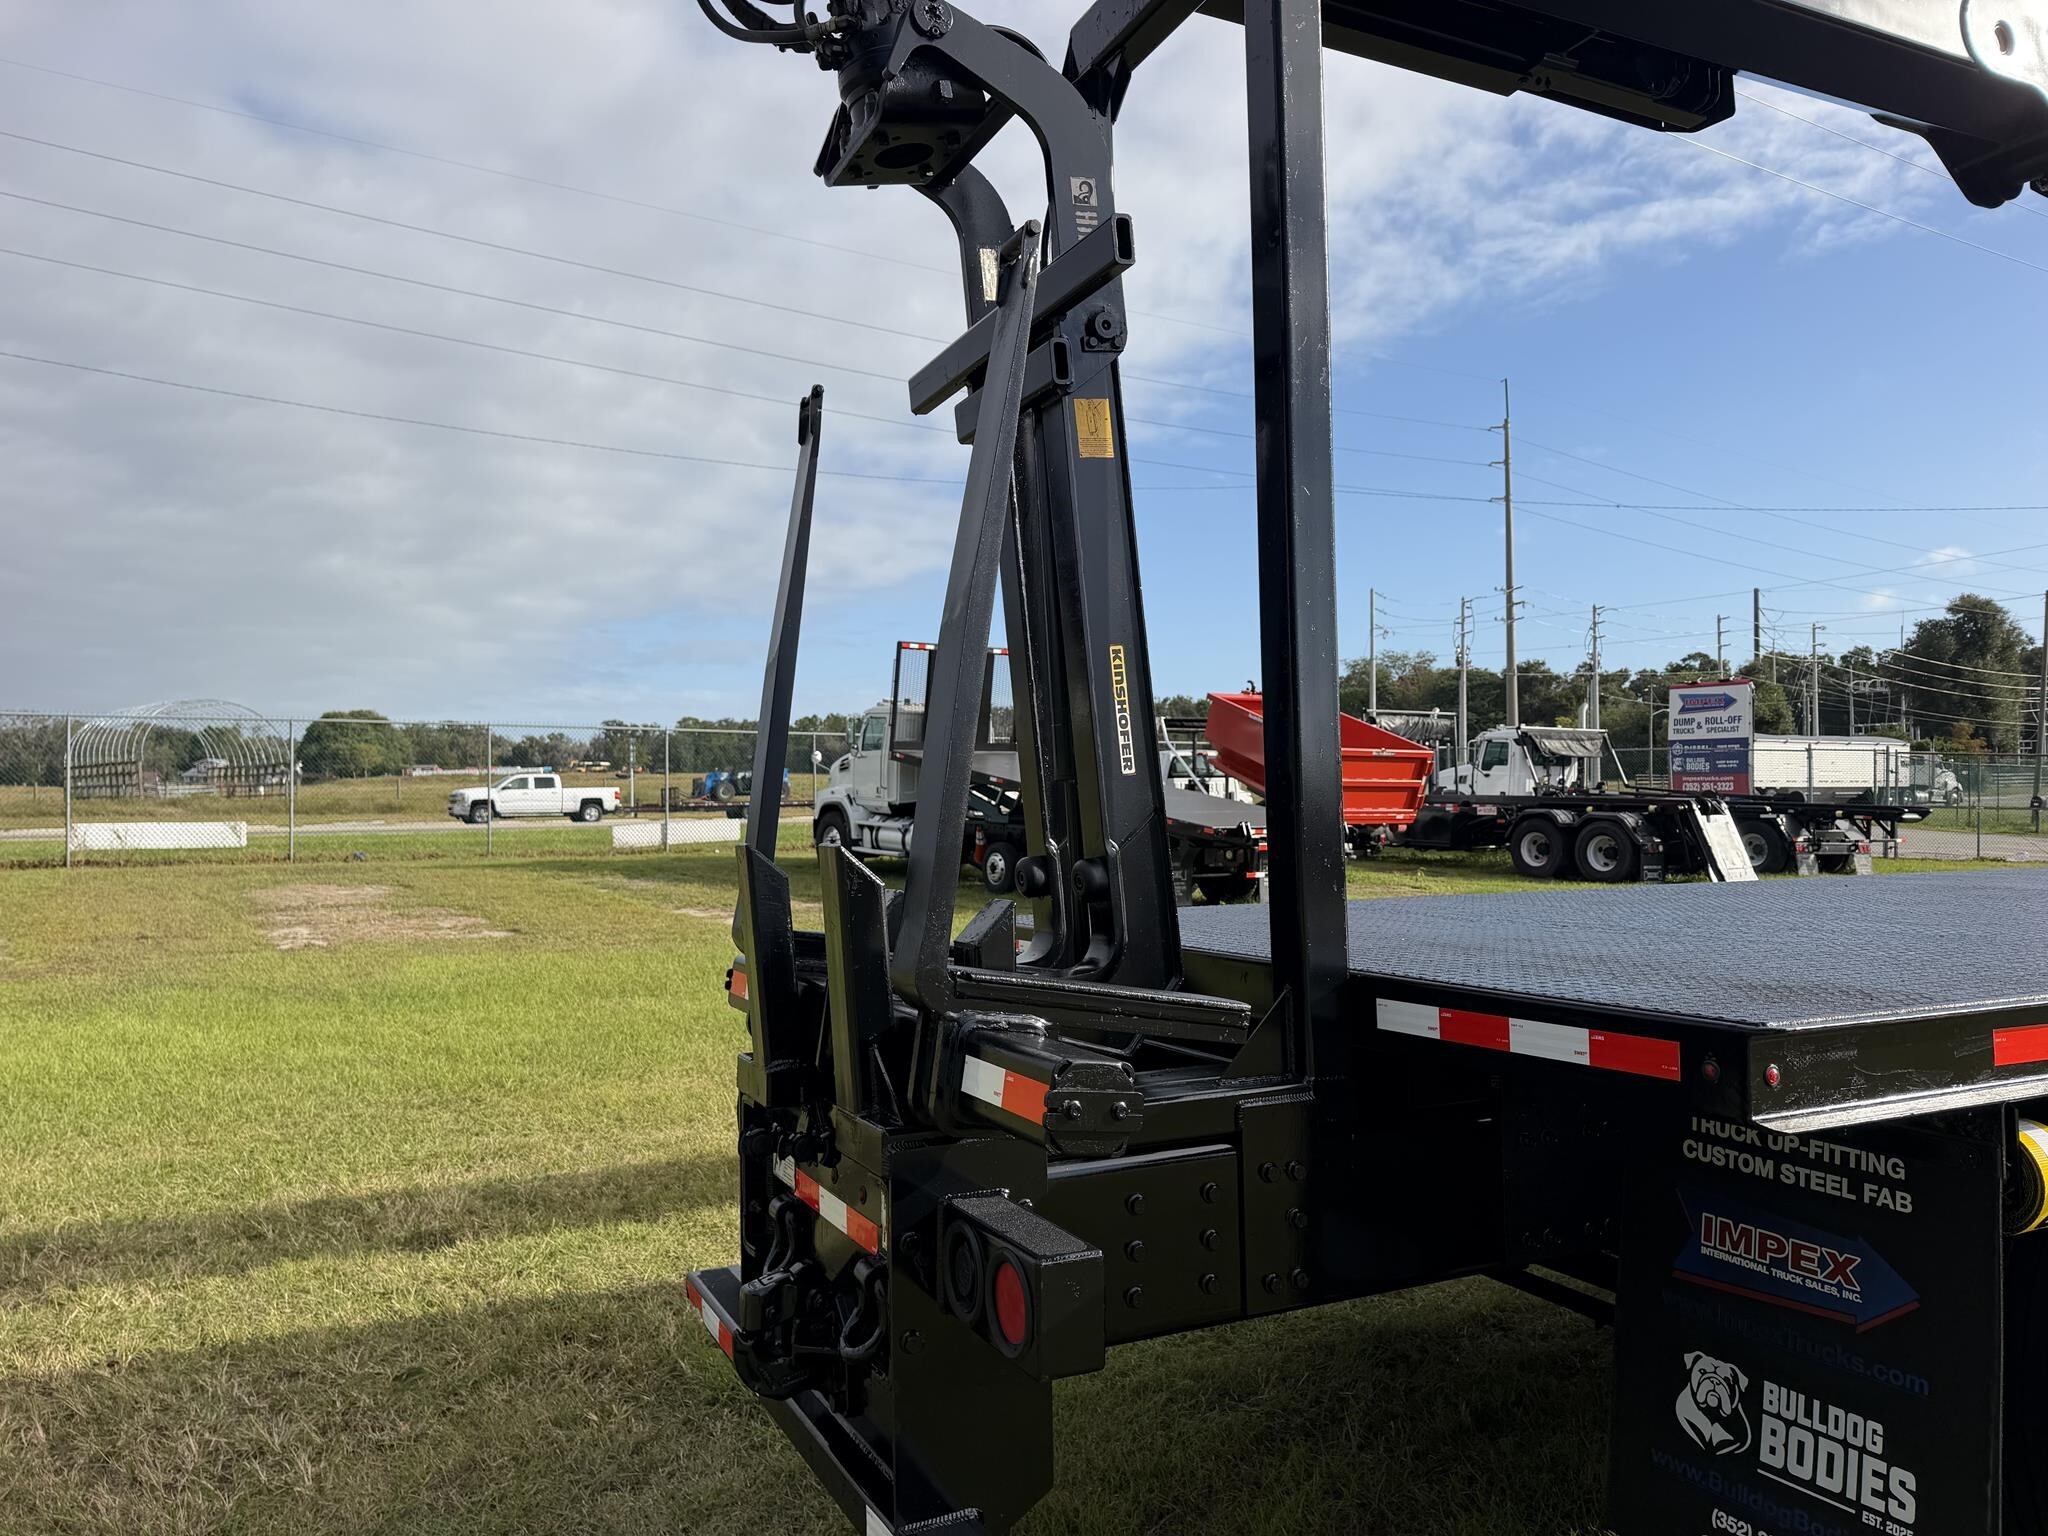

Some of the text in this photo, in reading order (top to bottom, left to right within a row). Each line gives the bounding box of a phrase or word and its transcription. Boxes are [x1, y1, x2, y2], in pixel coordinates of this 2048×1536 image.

[1111, 648, 1133, 771] KINSHOFER
[1673, 718, 1695, 726] DUMP
[1696, 721, 1702, 729] &
[1705, 715, 1742, 725] ROLL-OFF
[1686, 762, 1710, 771] BODIES
[1682, 1138, 1914, 1214] CUSTOM STEEL FAB
[1767, 1133, 1906, 1181] UP-FITTING
[1700, 1245, 1770, 1275] INTERNATIONAL
[1770, 1267, 1804, 1286] TRUCK
[1805, 1278, 1840, 1298] SALES,
[1701, 1212, 1862, 1292] IMPEX
[1762, 1380, 1884, 1455] BULLDOG
[1759, 1413, 1917, 1525] BODIES
[1711, 1508, 1753, 1536] (352)
[1861, 1510, 1884, 1530] EST.
